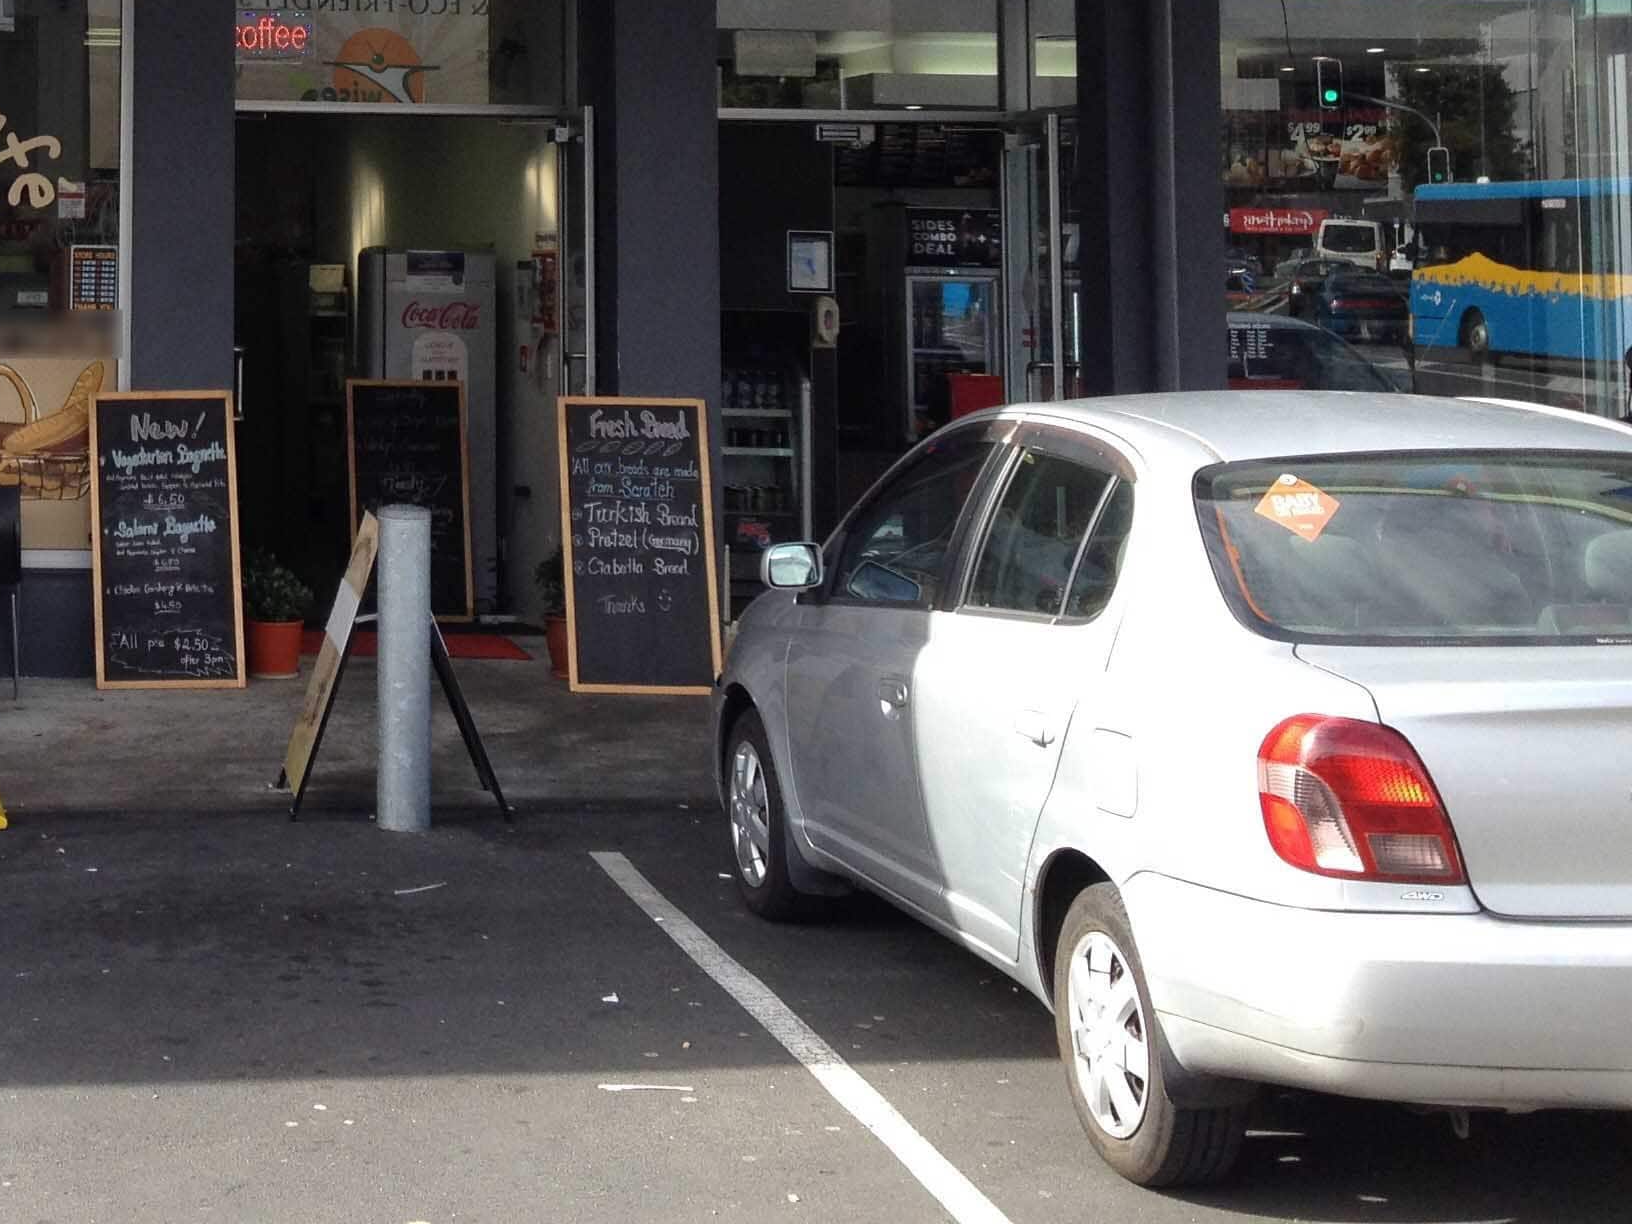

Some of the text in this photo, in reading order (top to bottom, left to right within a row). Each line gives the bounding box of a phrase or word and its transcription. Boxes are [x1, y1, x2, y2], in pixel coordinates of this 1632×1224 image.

[912, 232, 957, 242] COMBO
[914, 242, 956, 255] DEAL
[401, 301, 481, 330] Coca-Cola
[589, 408, 691, 440] Fresh Bread
[583, 500, 700, 528] Turkish Bread
[113, 517, 159, 539] Salami
[587, 526, 639, 549] Pretzel
[119, 634, 138, 649] All
